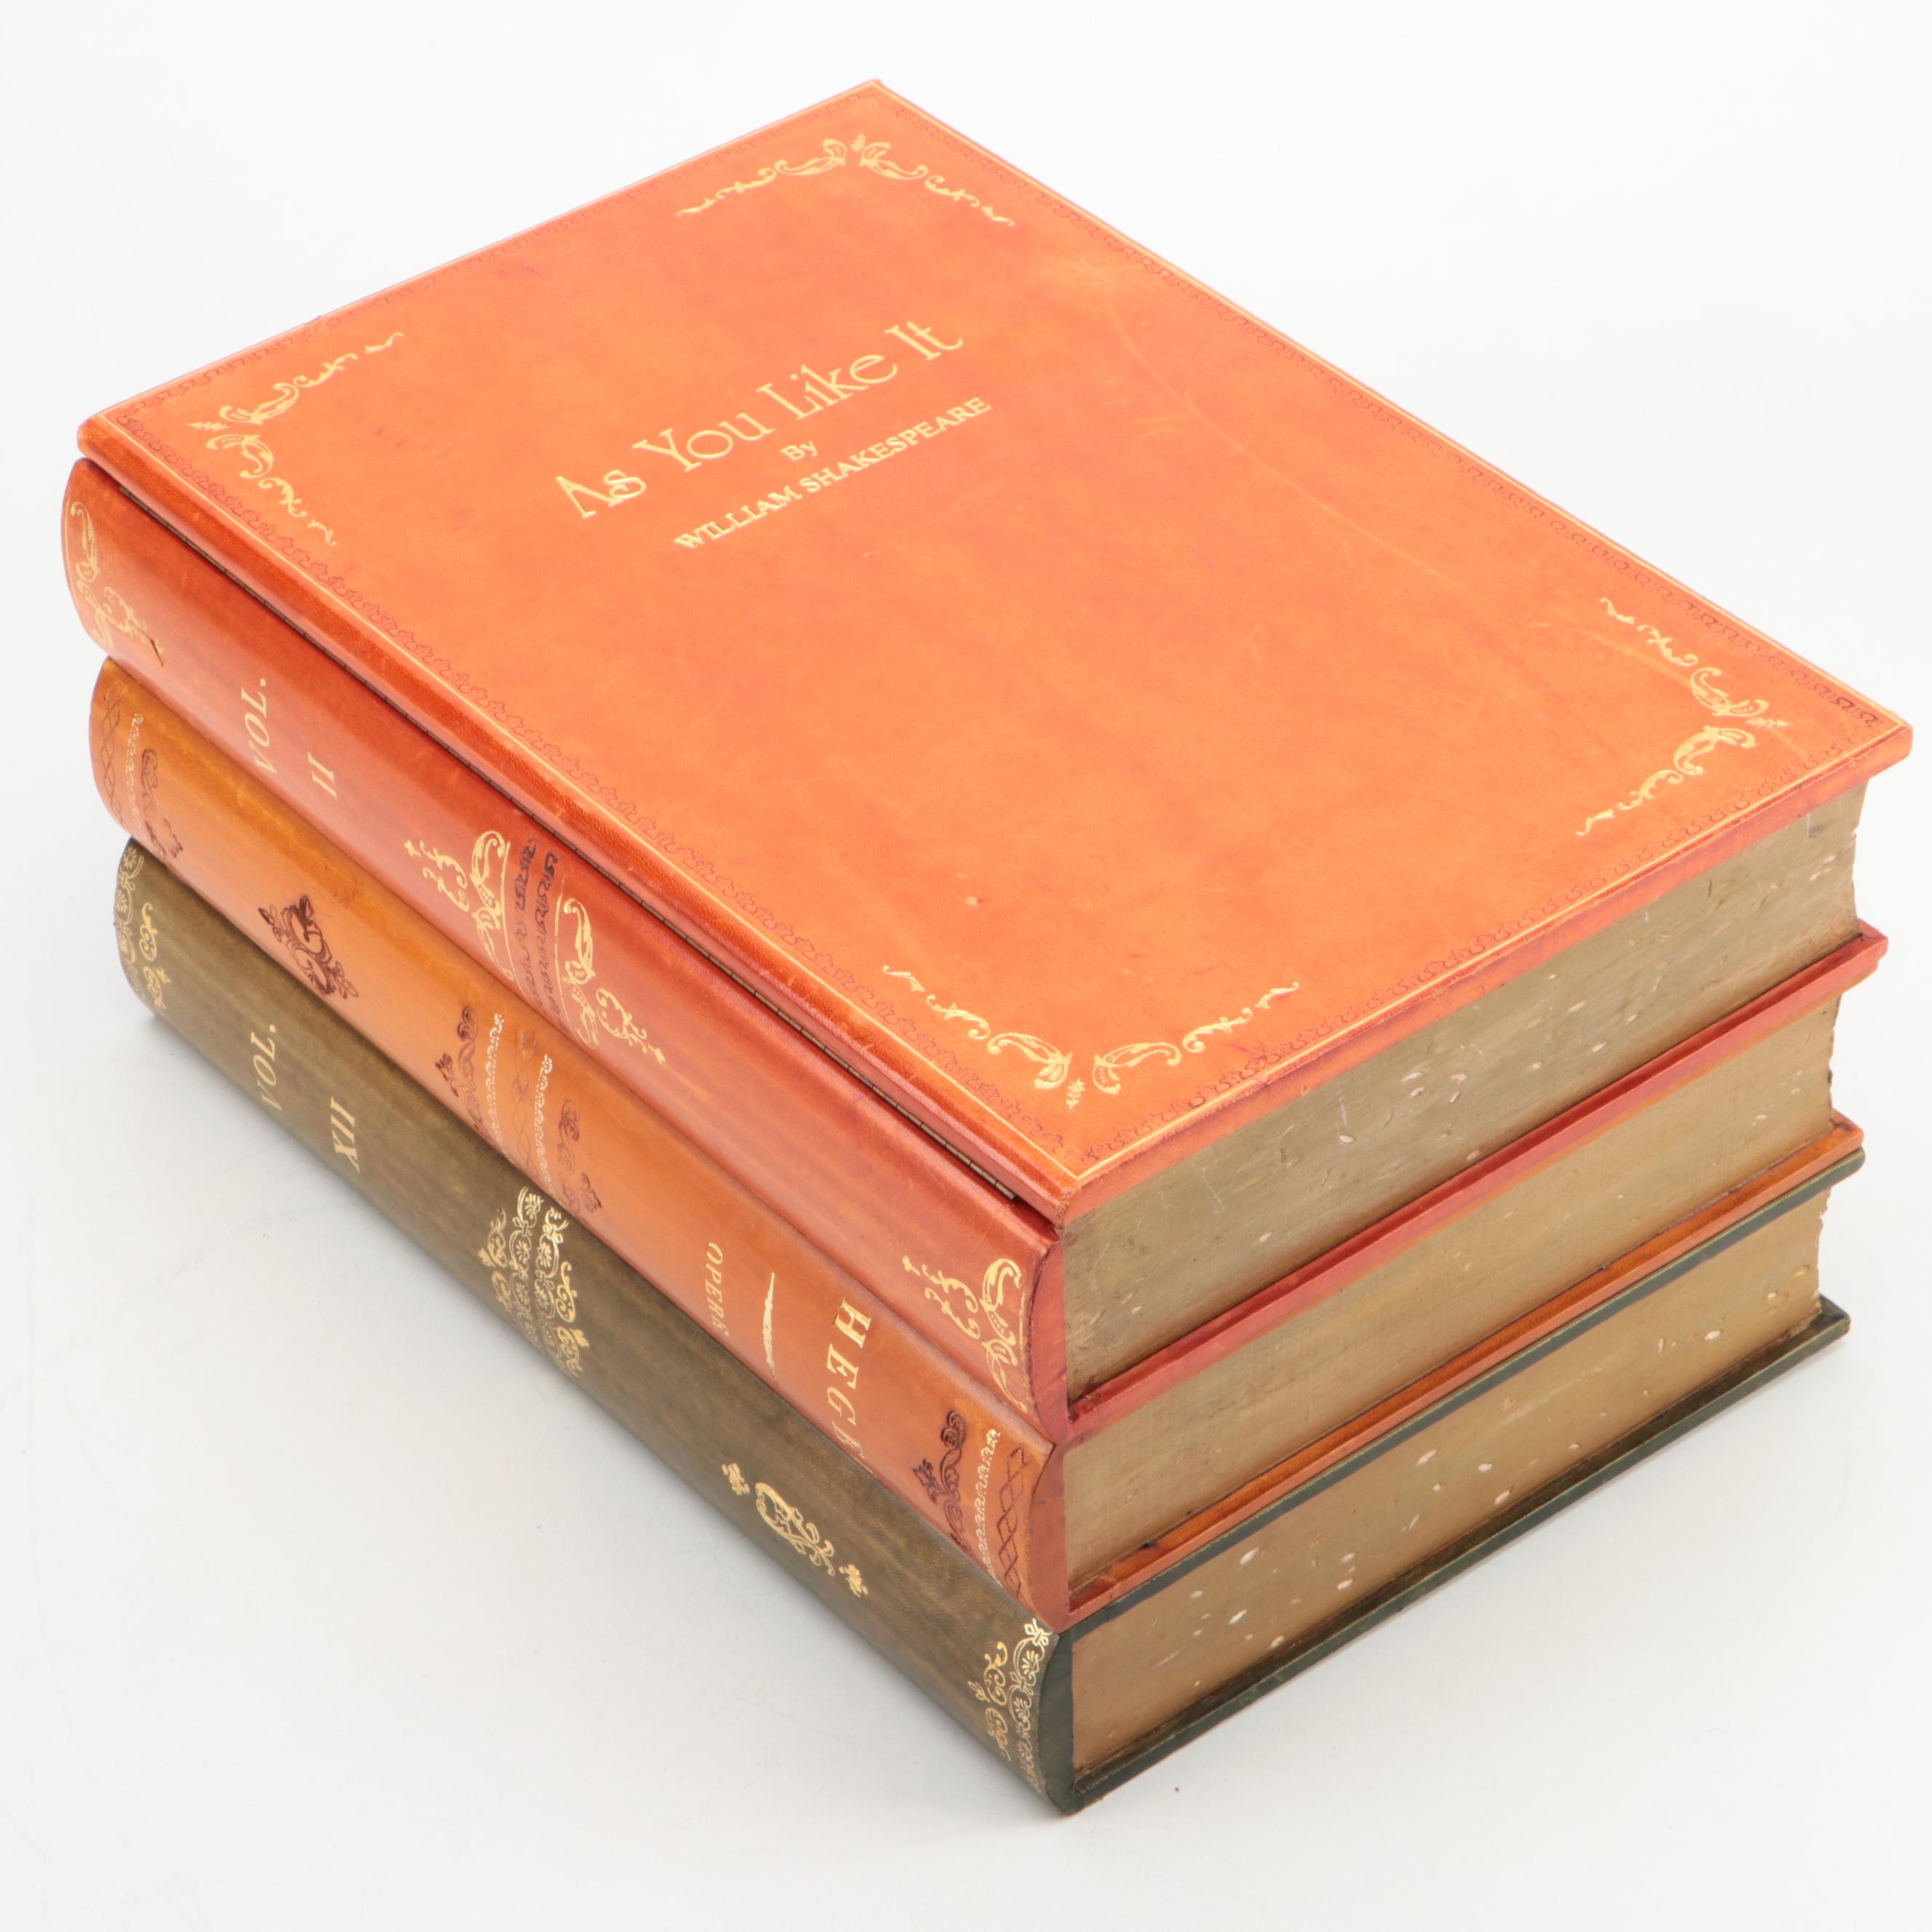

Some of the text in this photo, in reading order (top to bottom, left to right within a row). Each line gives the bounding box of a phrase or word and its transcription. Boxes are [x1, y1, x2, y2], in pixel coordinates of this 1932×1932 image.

[556, 320, 964, 518] As You Like It
[780, 440, 820, 461] By
[674, 396, 991, 548] WILLIAM SHAKESPEARE
[241, 677, 278, 775] VOL.
[308, 751, 338, 800] II
[250, 1023, 283, 1111] VOL.
[330, 1095, 361, 1173] XII
[826, 1297, 874, 1474] HEGE
